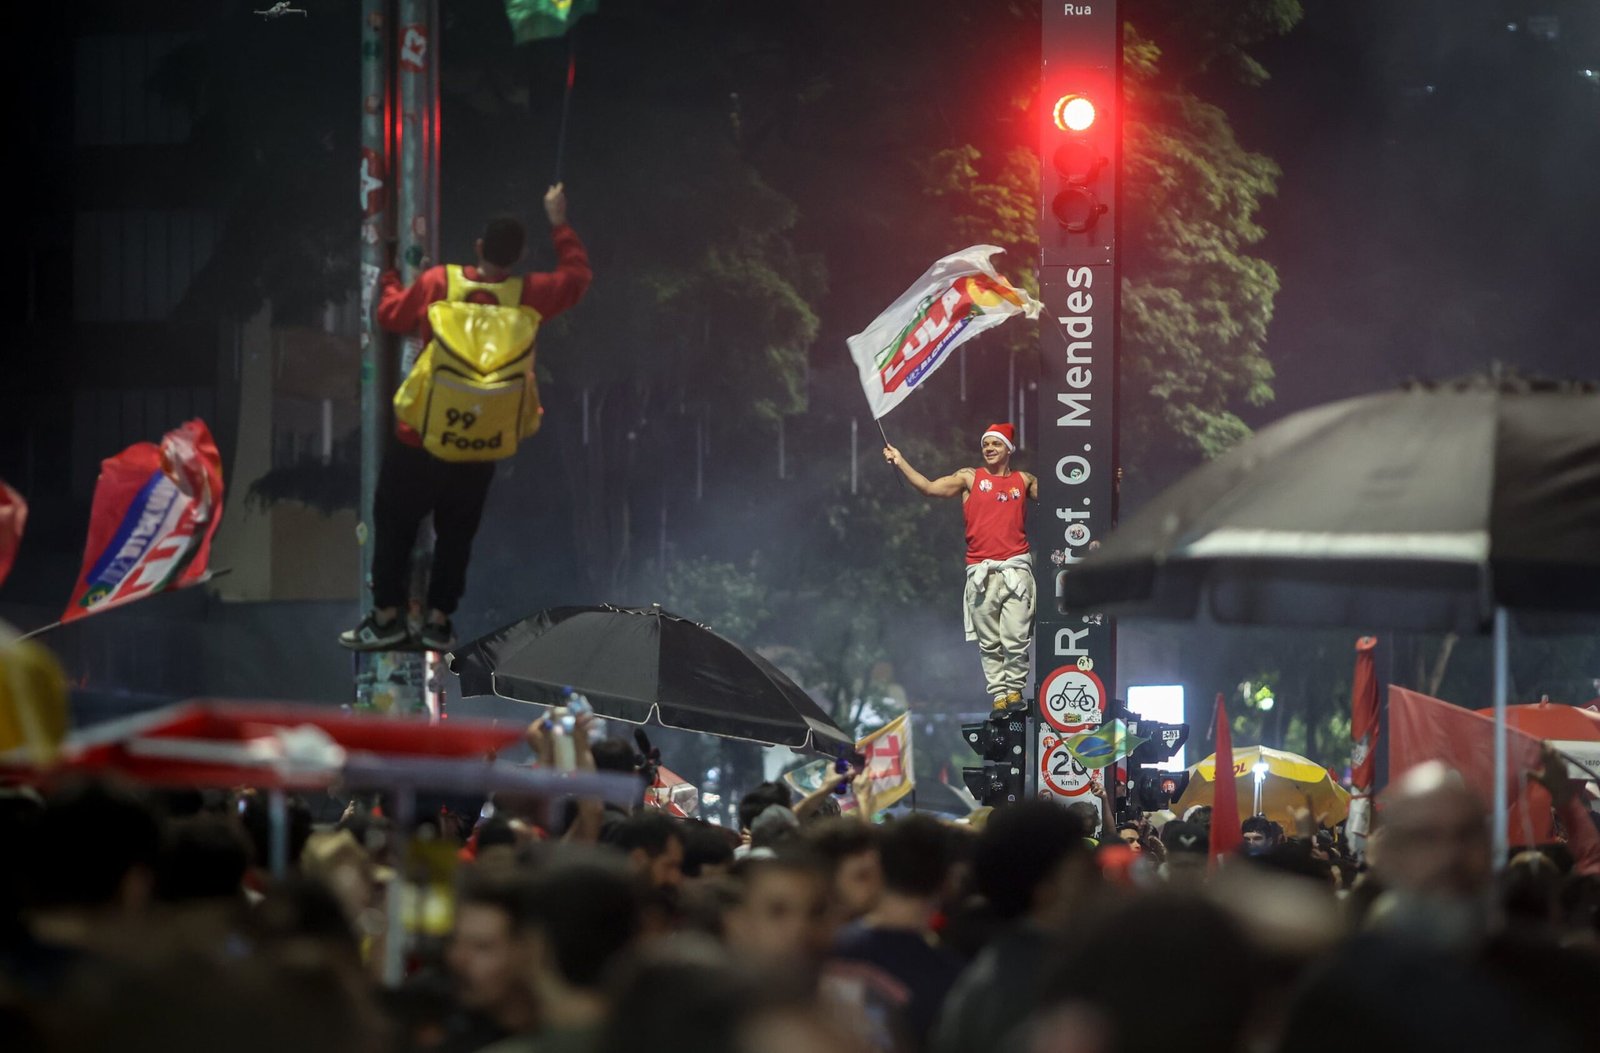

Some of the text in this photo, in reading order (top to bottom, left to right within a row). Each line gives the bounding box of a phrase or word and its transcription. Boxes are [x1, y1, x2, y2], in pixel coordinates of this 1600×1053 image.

[1064, 3, 1092, 16] Rua
[884, 286, 962, 385] LULA
[446, 408, 476, 430] 99
[441, 431, 502, 450] Food
[1054, 266, 1093, 656] R. rof. O. Mendes
[1053, 751, 1087, 776] 20
